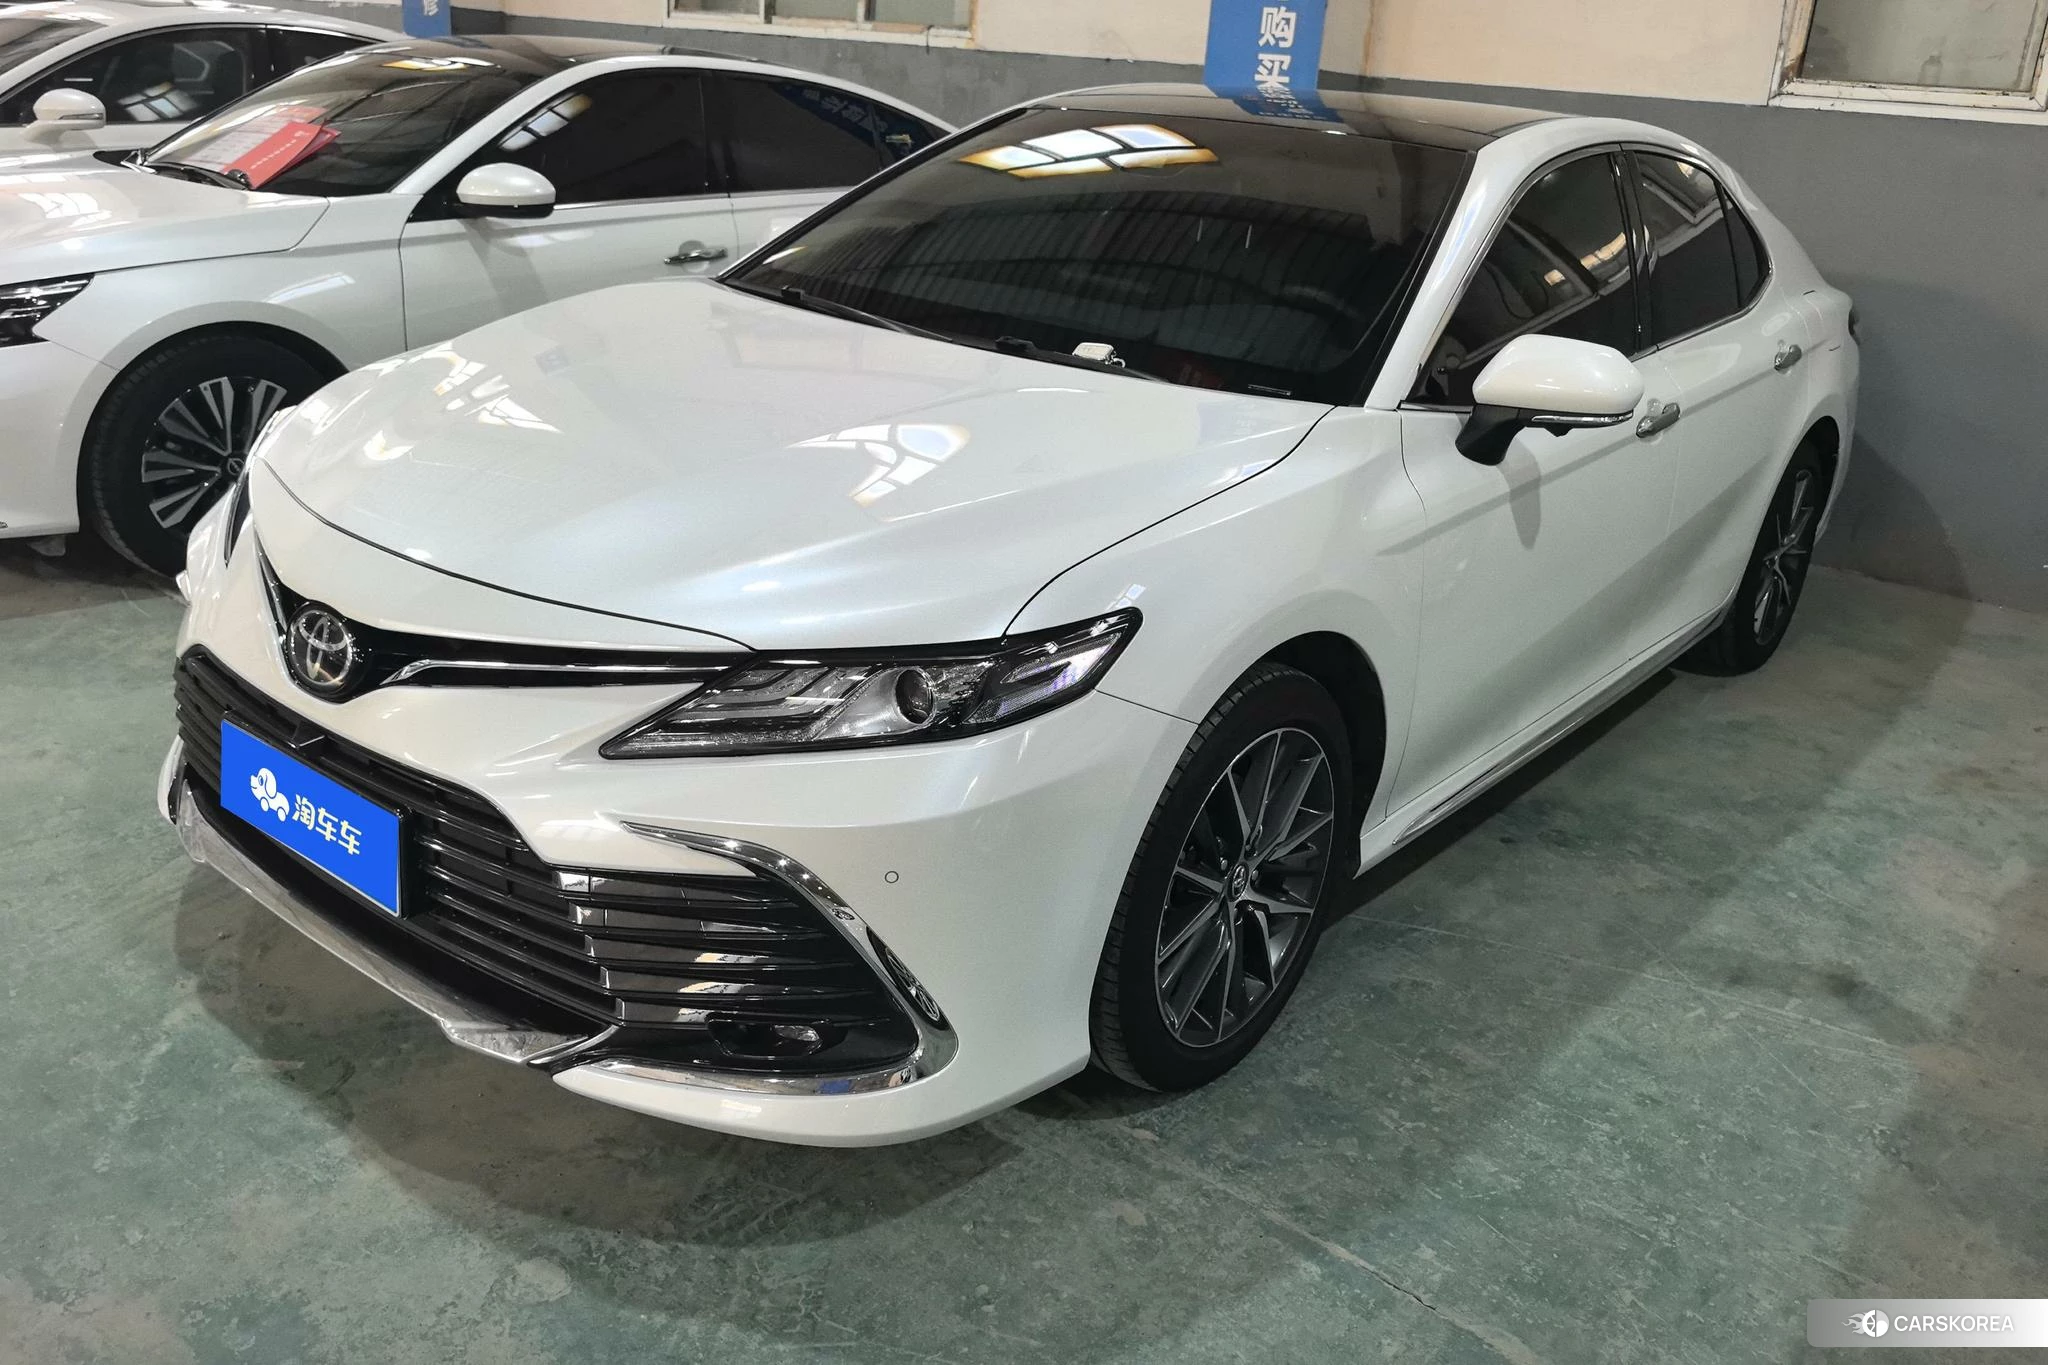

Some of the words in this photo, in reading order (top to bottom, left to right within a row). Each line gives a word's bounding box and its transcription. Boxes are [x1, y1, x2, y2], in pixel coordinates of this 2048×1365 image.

[1254, 6, 1296, 92] 购买
[292, 794, 362, 855] 淘车车
